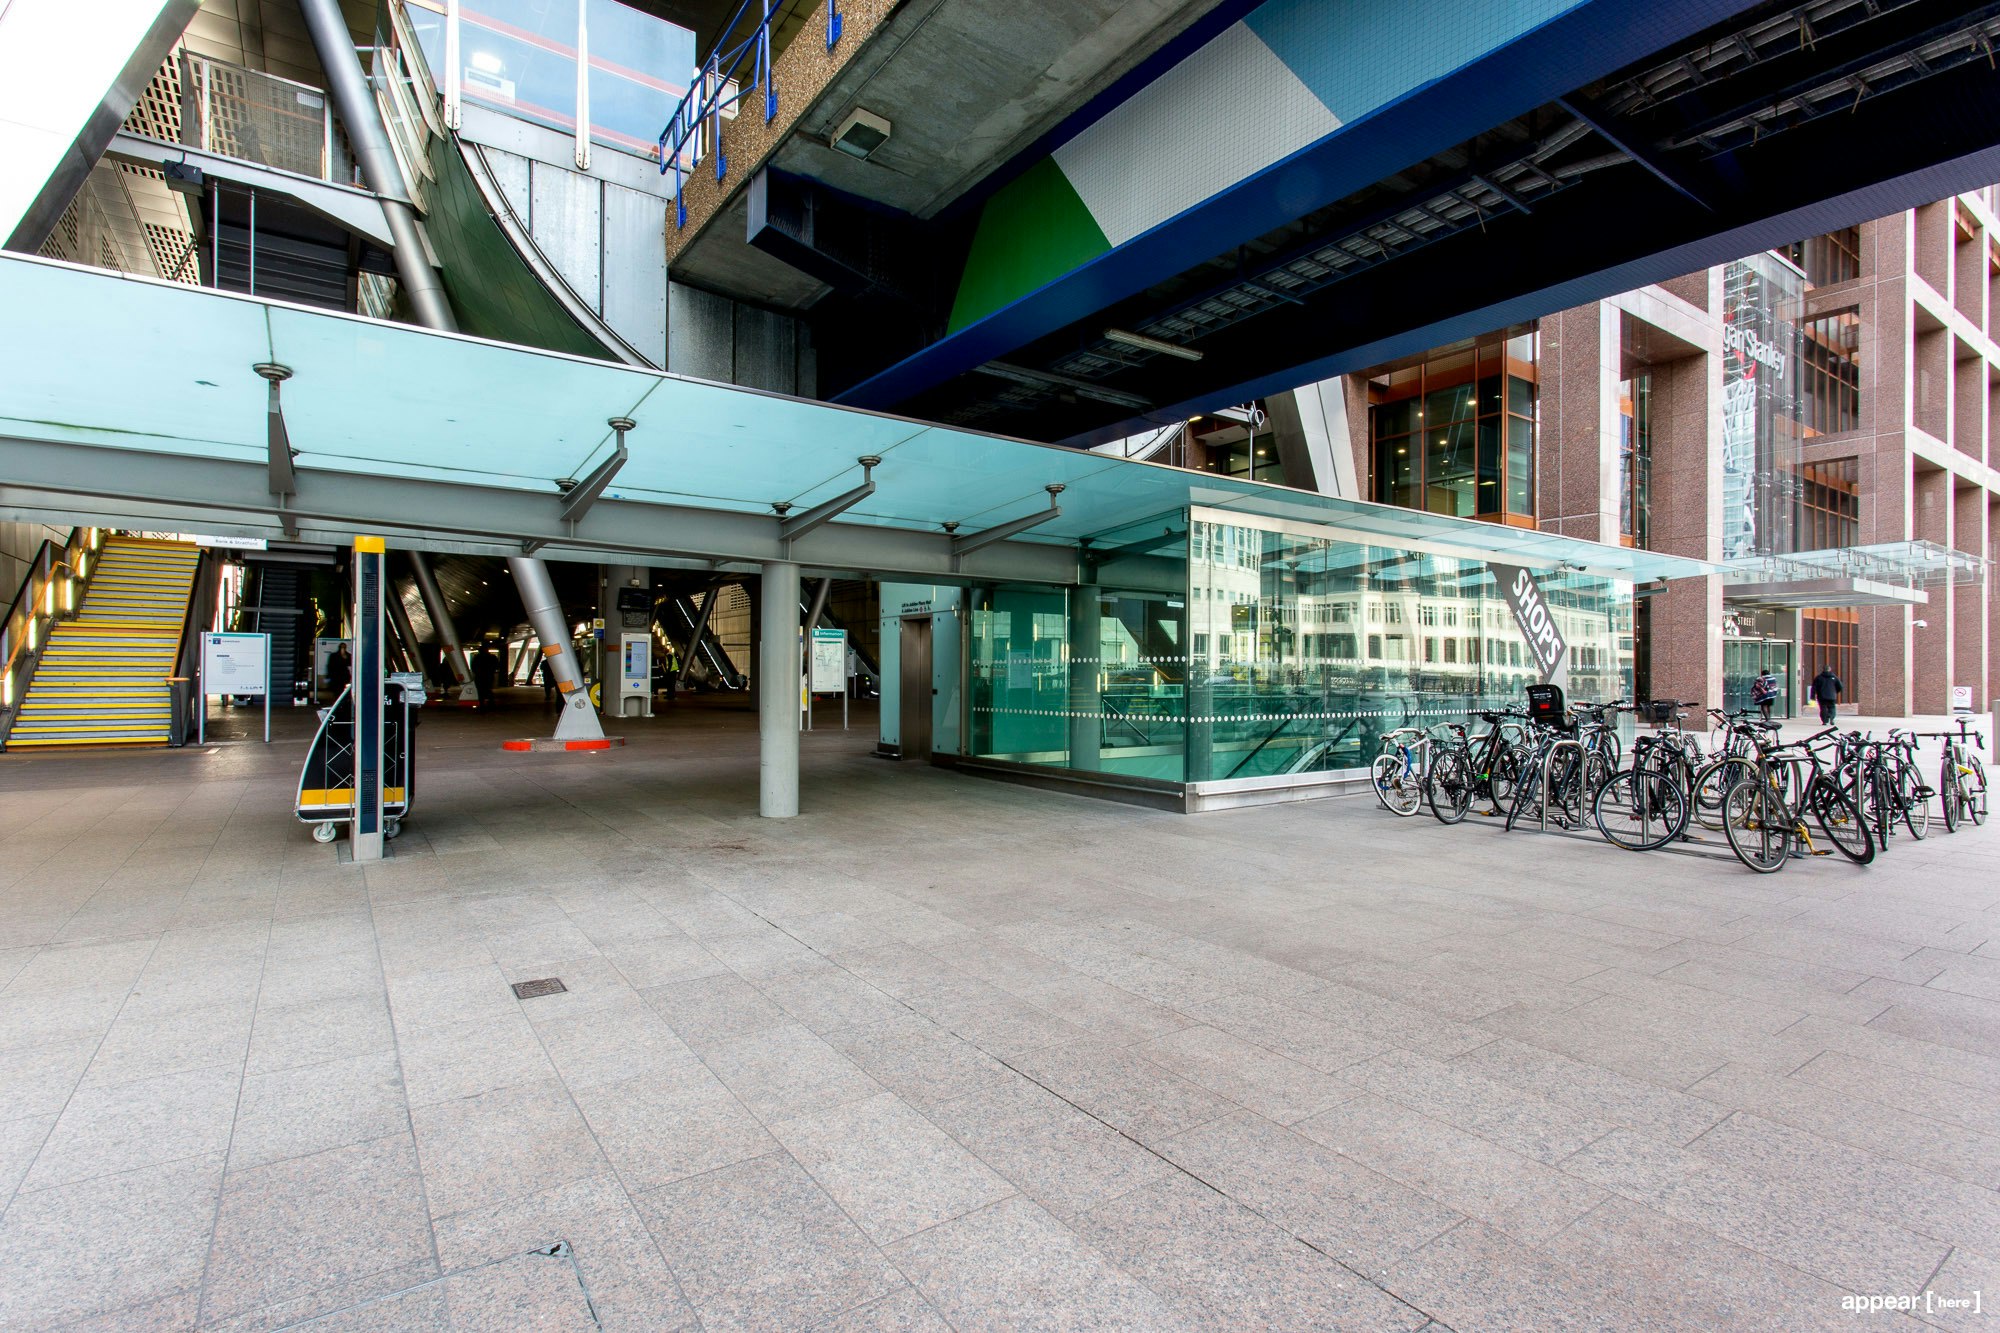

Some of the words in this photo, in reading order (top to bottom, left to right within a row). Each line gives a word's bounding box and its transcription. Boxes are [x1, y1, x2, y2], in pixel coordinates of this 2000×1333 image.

[1723, 323, 1744, 352] gan
[1744, 328, 1785, 379] Stanley
[1512, 569, 1561, 665] SHOPS
[1737, 616, 1755, 627] STREET
